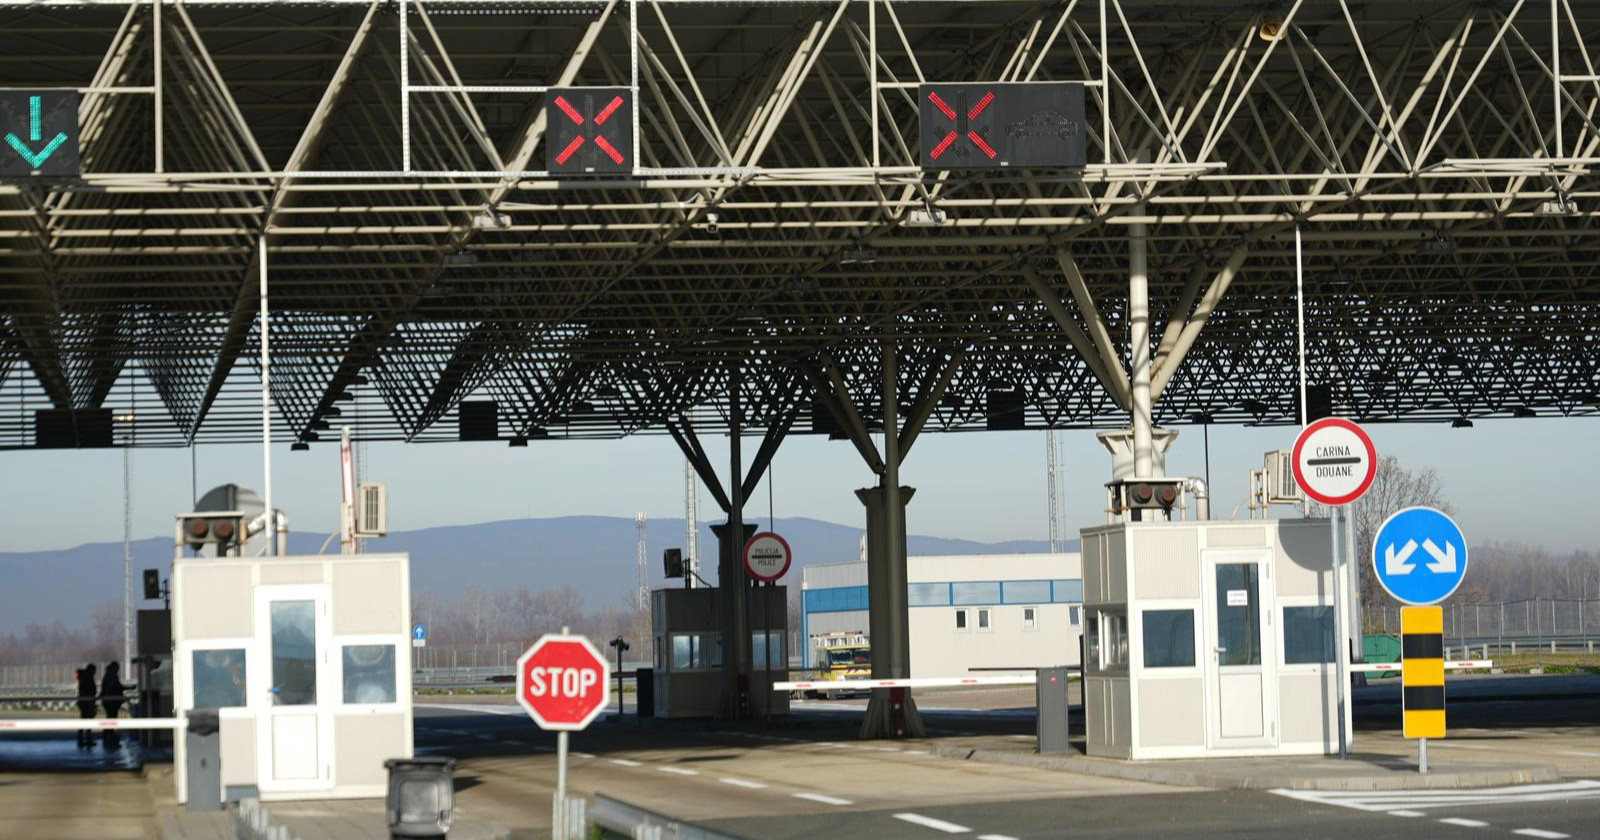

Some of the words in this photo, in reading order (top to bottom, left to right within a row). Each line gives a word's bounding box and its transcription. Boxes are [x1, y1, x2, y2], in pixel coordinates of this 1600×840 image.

[1316, 445, 1351, 457] CARINA
[1316, 466, 1353, 478] DOUANE
[758, 559, 776, 567] POLICE
[530, 666, 597, 698] STOP
